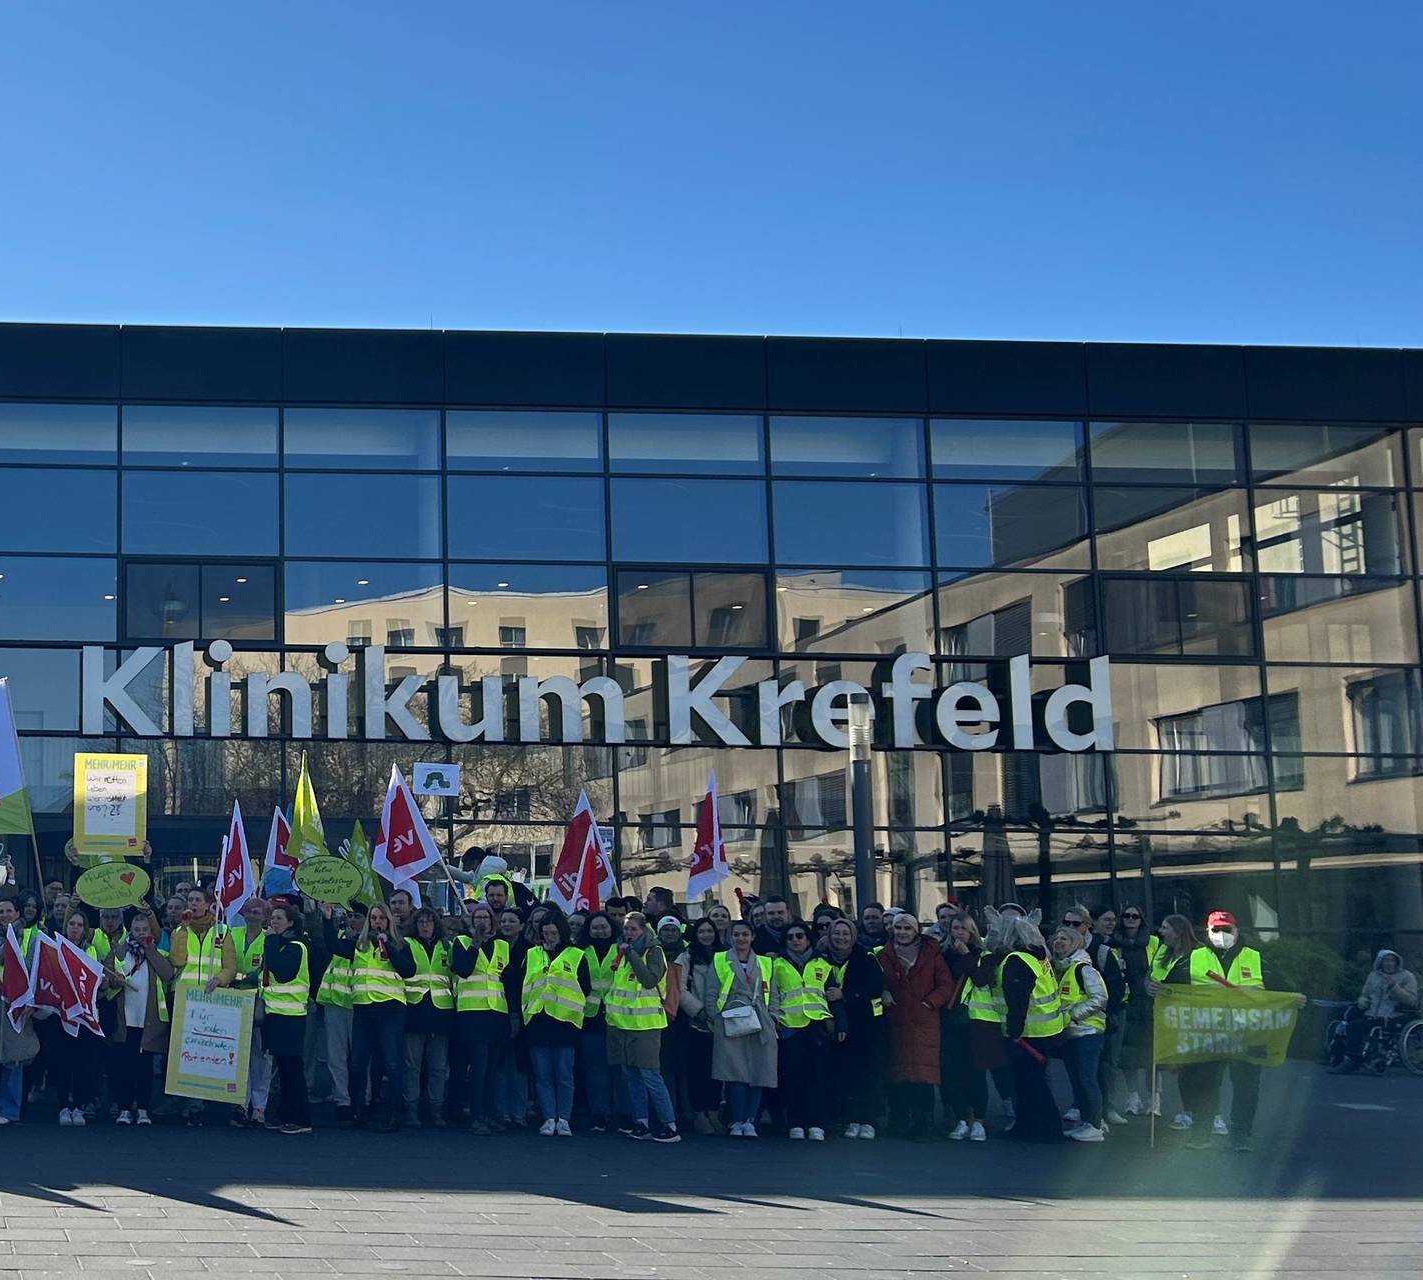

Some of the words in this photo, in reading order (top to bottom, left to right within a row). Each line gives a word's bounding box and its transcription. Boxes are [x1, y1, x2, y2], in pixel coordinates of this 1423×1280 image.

[82, 640, 626, 744] Klinikum
[667, 652, 1115, 752] Krefeld
[1163, 1006, 1292, 1030] GEMEINSAM
[1175, 1032, 1244, 1053] STARK
